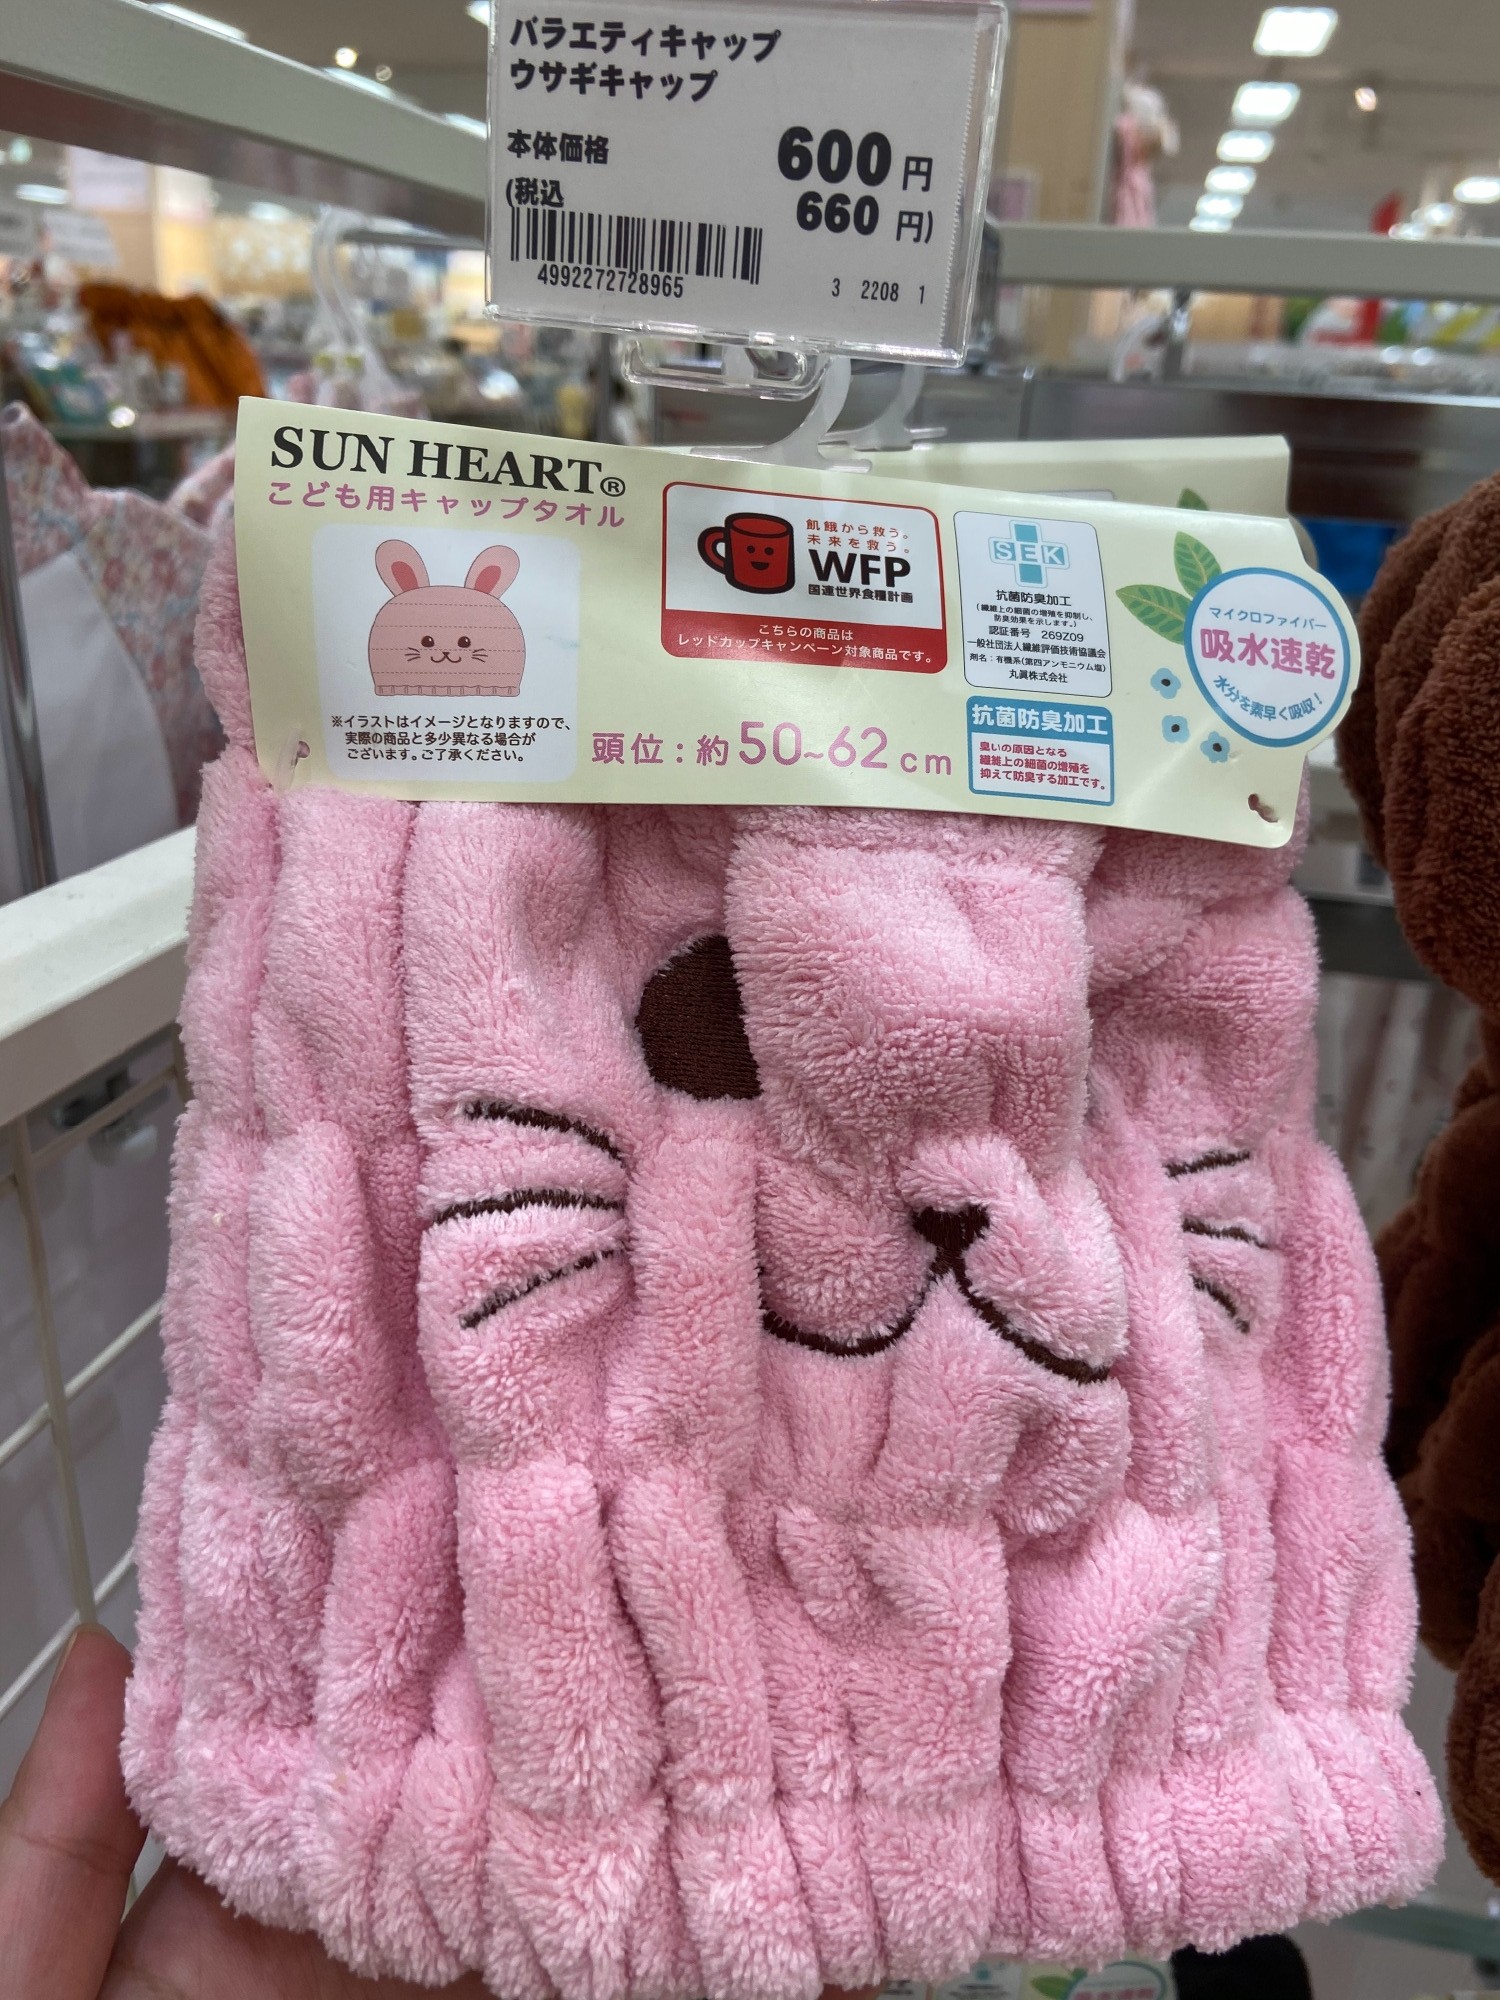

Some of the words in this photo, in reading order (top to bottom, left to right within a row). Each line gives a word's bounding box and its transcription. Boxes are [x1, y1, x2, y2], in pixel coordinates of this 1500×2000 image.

[511, 16, 781, 62] バラエティキャップ
[511, 59, 718, 102] ウサギキャップ
[507, 130, 610, 165] 本体価格
[777, 126, 892, 187] 600
[902, 156, 933, 192] 円
[506, 177, 565, 208] (税込
[796, 191, 879, 236] 660
[896, 209, 934, 244] 円)
[537, 263, 684, 299] 4992272728965
[831, 278, 841, 298] 3
[861, 280, 899, 303] 2208
[918, 285, 926, 305] 1
[271, 425, 395, 475] SUN
[268, 481, 625, 528] こども用キャップタオル
[805, 518, 909, 540] 飢餓から救う。
[807, 534, 910, 554] 未来を救う。
[995, 541, 1065, 565] SEK
[808, 548, 911, 588] WFP
[807, 583, 914, 604] 国連世界食糧計画
[995, 589, 1072, 607] 抗菌防臭加工
[993, 614, 1078, 628] 防臭効果を示します。)
[1209, 607, 1327, 630] マイクロファイバー
[758, 623, 854, 641] こちらの商品は
[988, 625, 1031, 639] 認証番号
[1041, 630, 1084, 643] 269Z09
[678, 633, 933, 664] レッドカップキャンペーン対象商品です。
[967, 638, 1106, 659] 一般社団法人繊維評価技術協議会
[1200, 627, 1336, 680] 吸水速乾
[1213, 675, 1323, 722] 水分を素早く吸収！
[331, 715, 572, 731] ※イラストはイメージとなりますので、
[971, 703, 1109, 736] 抗菌防臭加工
[345, 731, 536, 747] 実際の商品と多少異なる場合が
[979, 741, 1068, 758] 臭いの原因となる
[347, 748, 525, 763] ございます。ご了承ください。
[979, 754, 1090, 775] 繊維上の細菌の増殖を
[979, 768, 1106, 791] 抑えて防臭する加工です。
